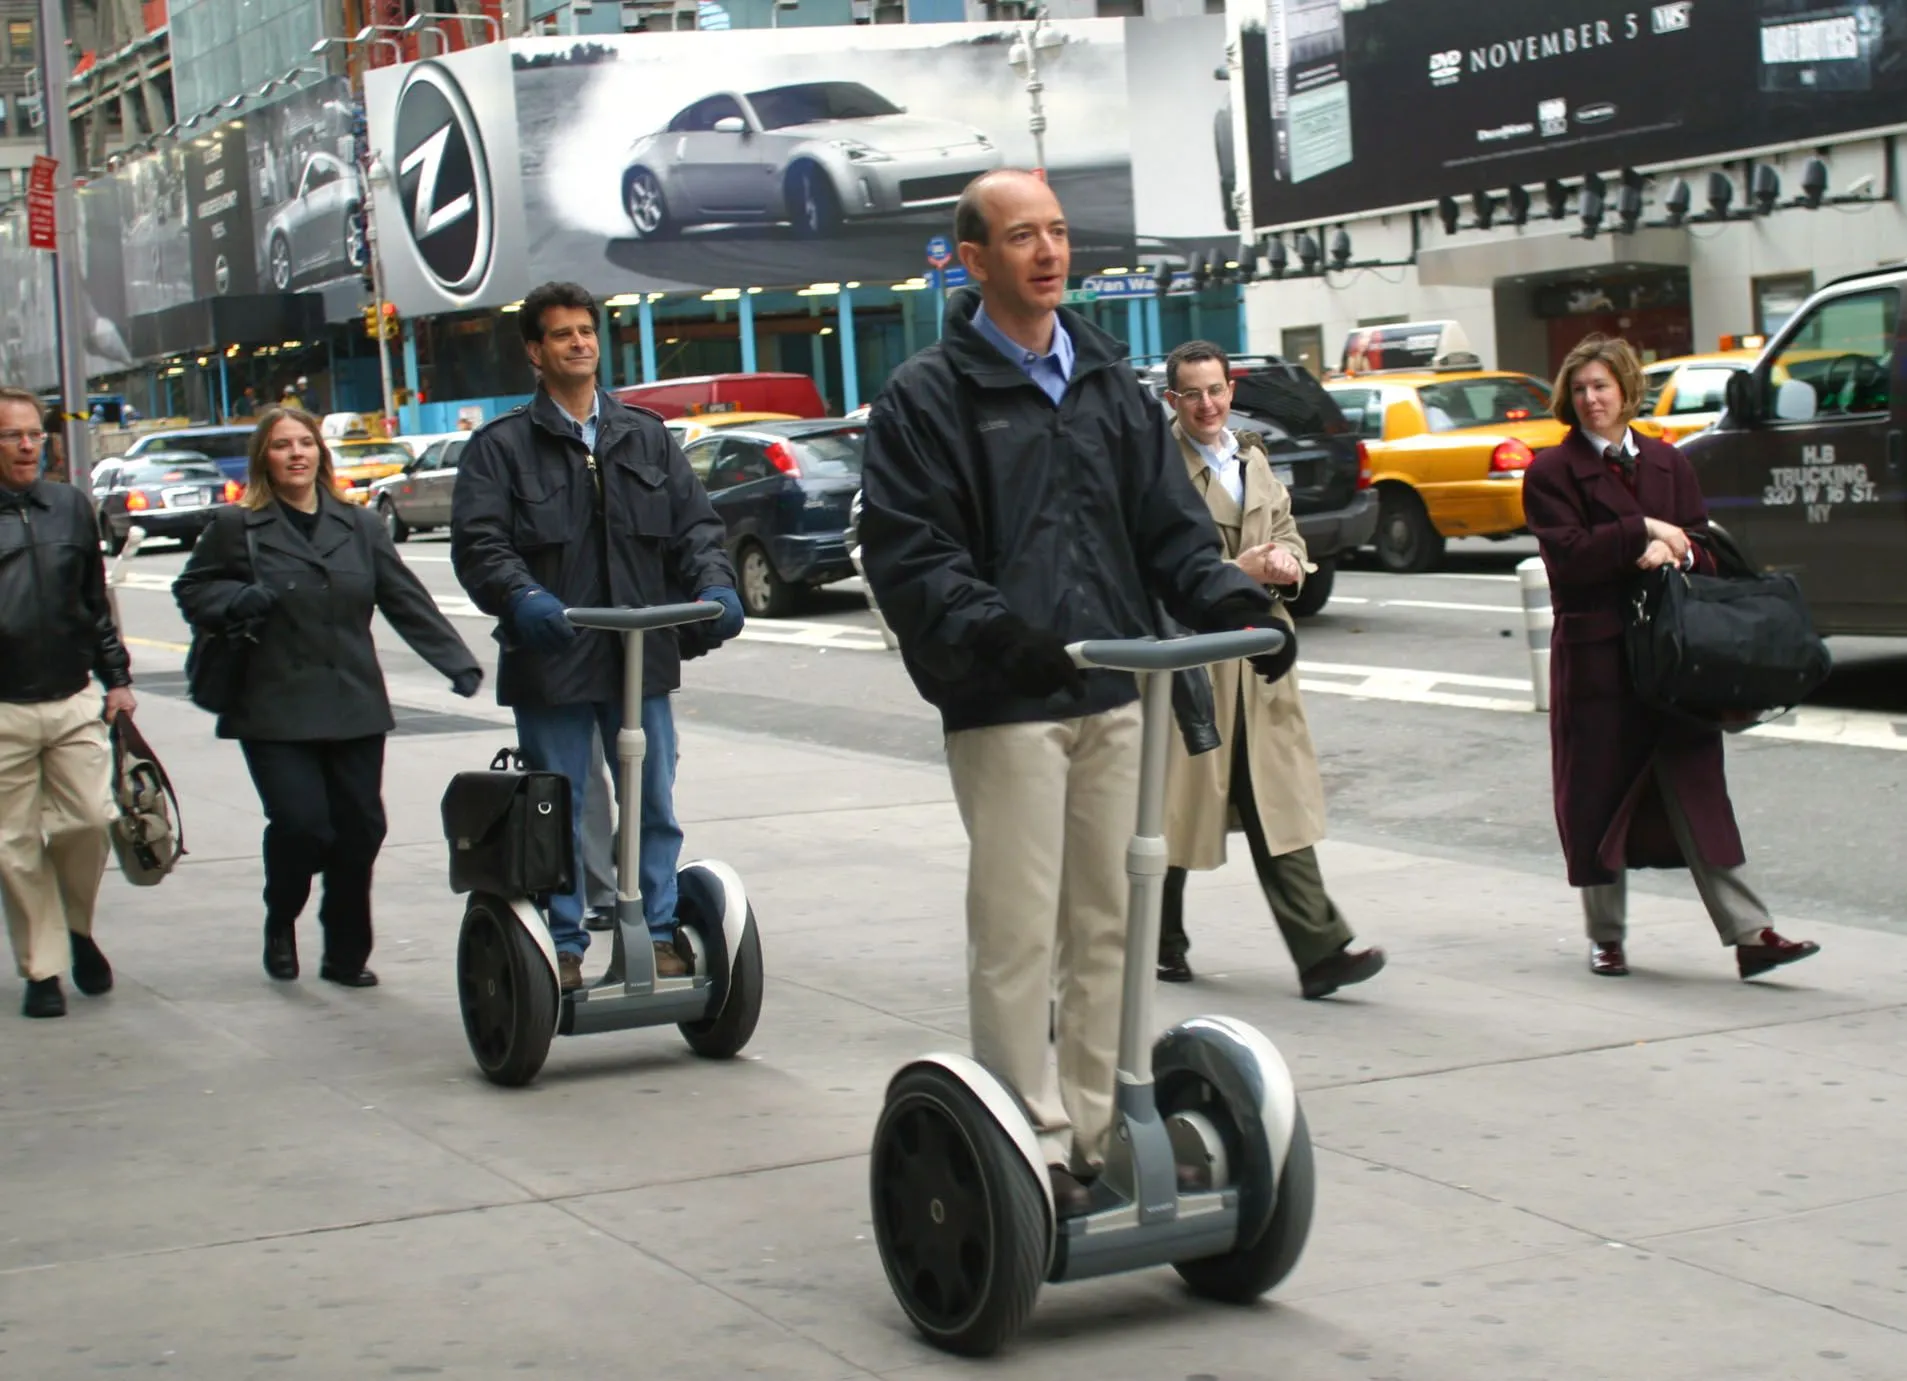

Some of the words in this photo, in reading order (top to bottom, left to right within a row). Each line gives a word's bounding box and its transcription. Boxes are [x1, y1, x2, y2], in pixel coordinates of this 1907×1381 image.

[1470, 20, 1613, 72] NOVEMBER
[1625, 13, 1639, 39] 5
[400, 121, 473, 240] Z
[1802, 444, 1836, 465] H.B
[1770, 463, 1868, 487] TRUCKING
[1801, 484, 1820, 503] W
[1850, 481, 1880, 503] ST.
[1807, 503, 1832, 523] NY
